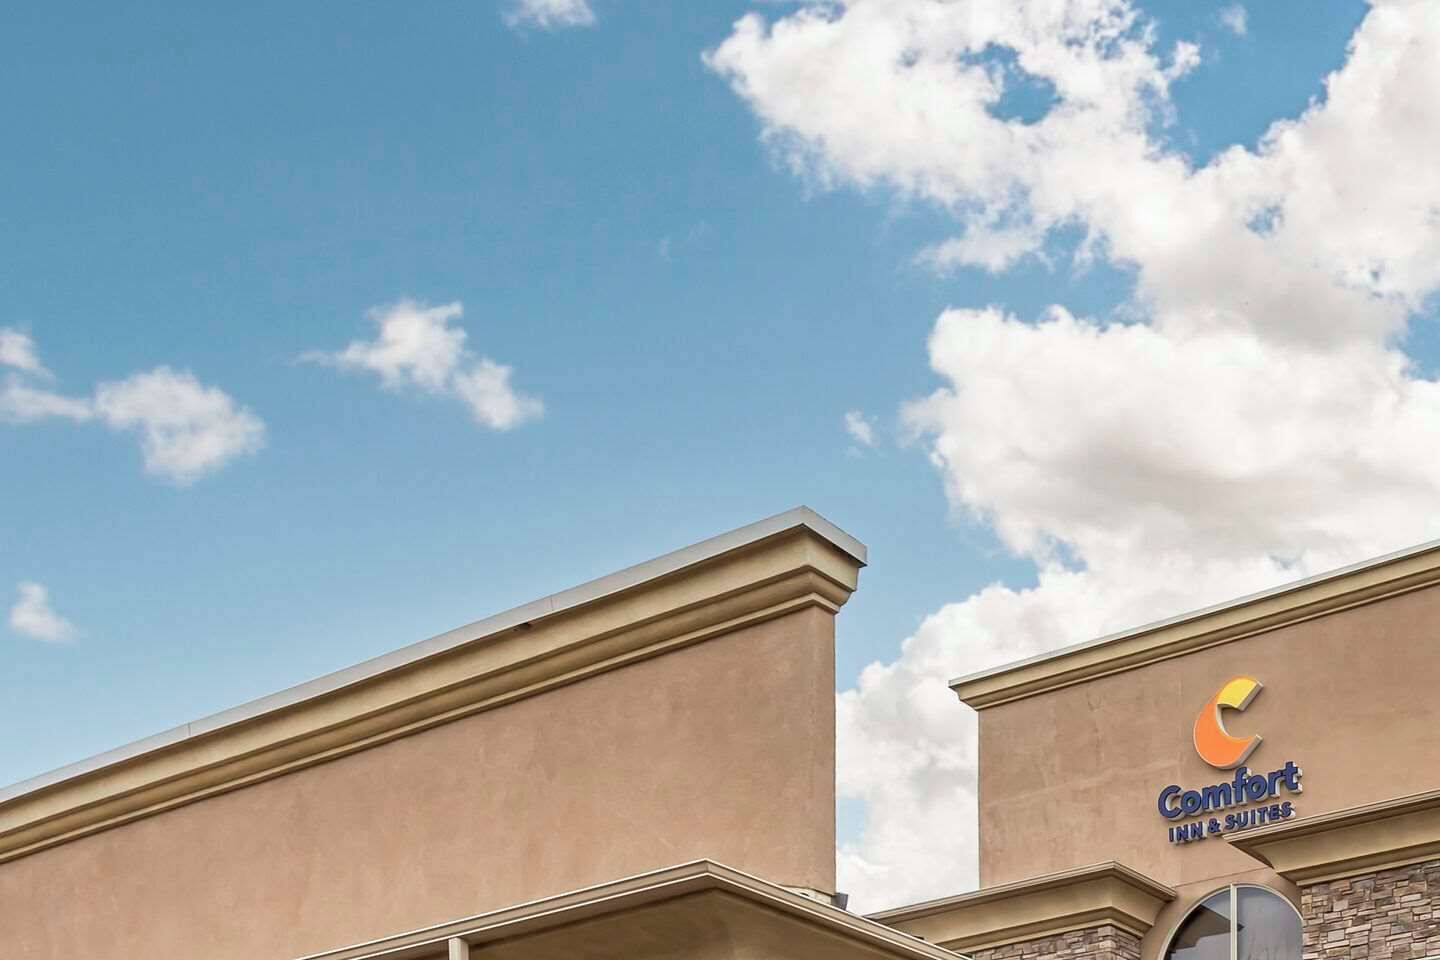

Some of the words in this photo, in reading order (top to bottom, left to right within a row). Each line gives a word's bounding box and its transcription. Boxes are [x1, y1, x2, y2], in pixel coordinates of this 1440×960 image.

[1158, 761, 1301, 819] Comfort
[1169, 821, 1205, 843] INN
[1208, 818, 1220, 833] &
[1225, 802, 1294, 830] SUITES
